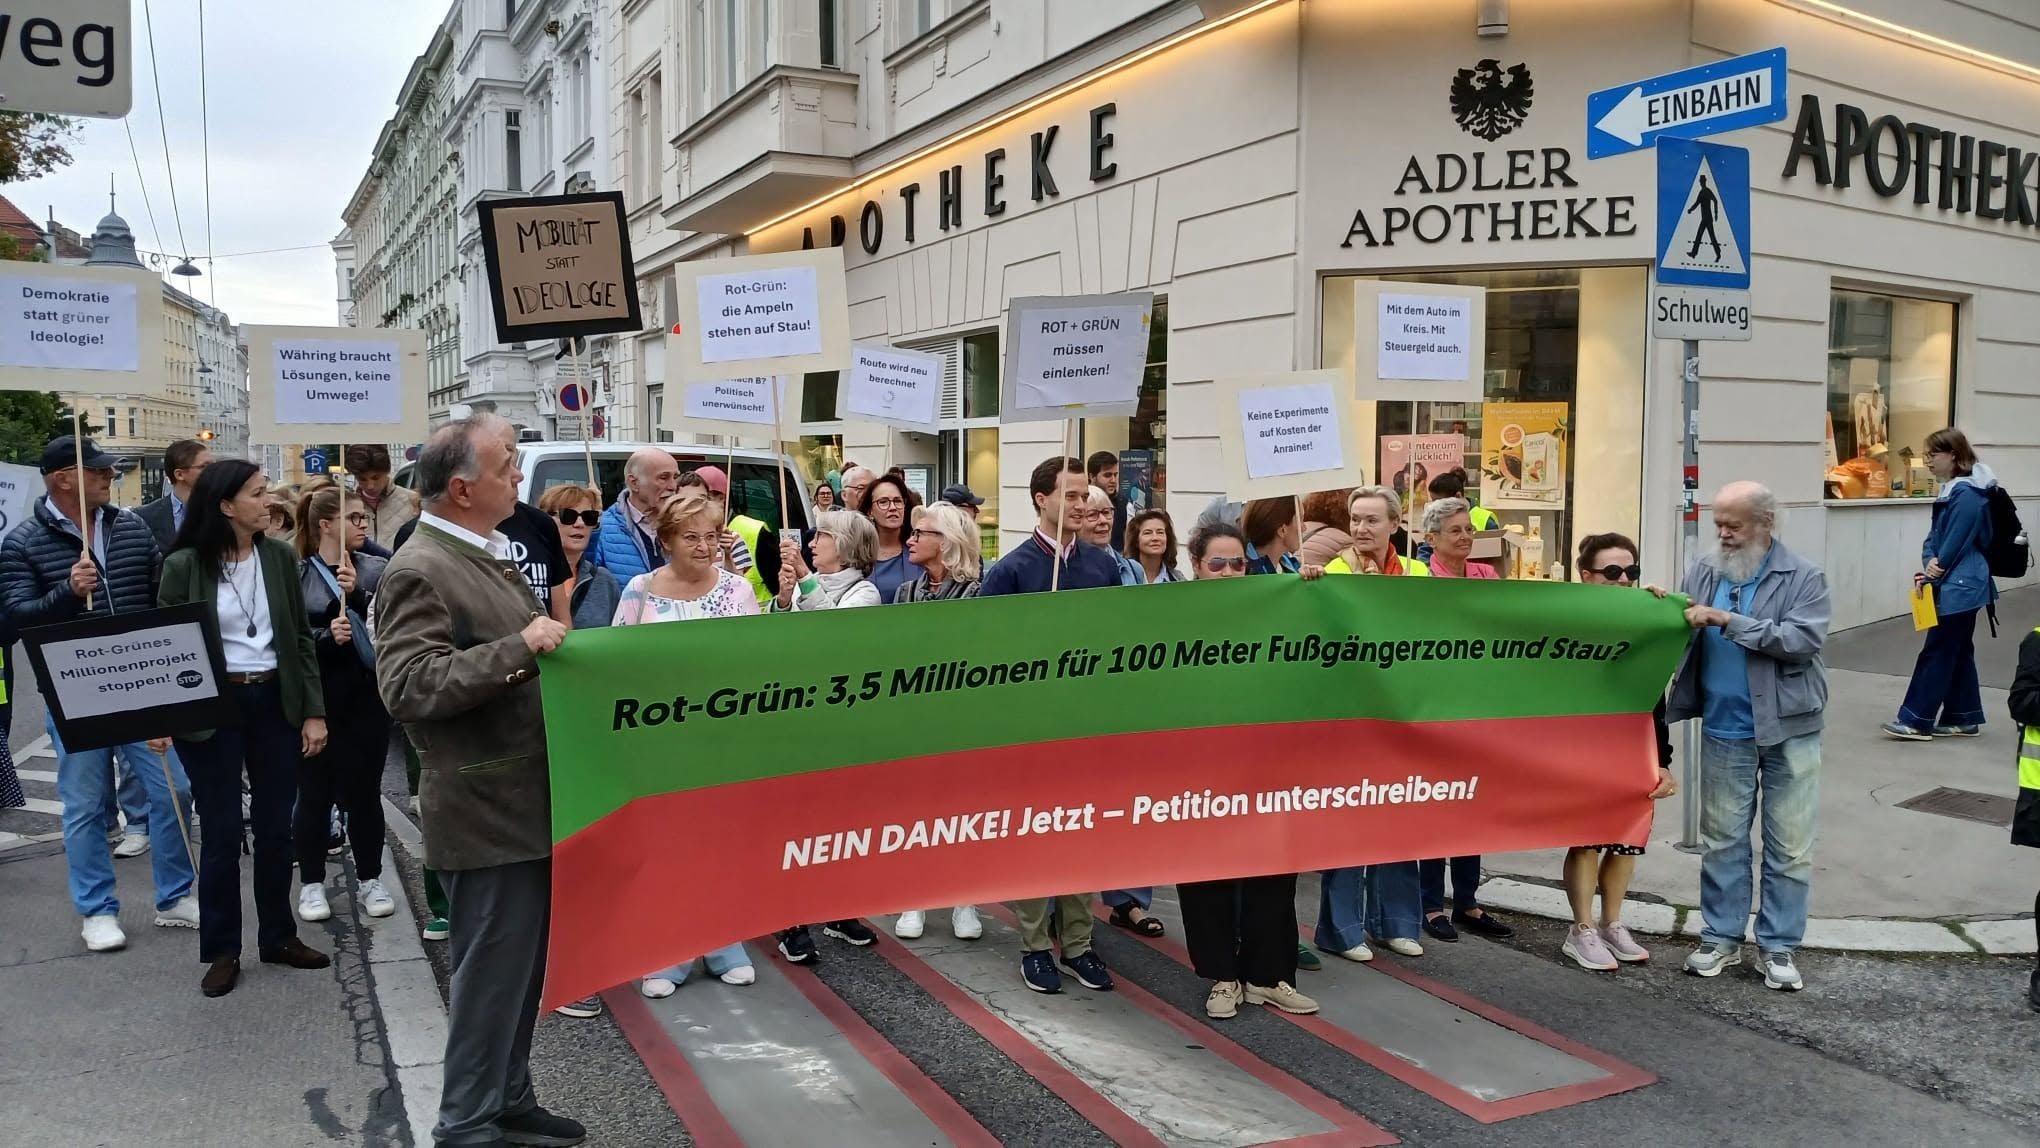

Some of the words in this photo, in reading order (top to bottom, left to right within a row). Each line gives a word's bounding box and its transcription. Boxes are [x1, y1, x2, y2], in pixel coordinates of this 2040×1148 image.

[1647, 74, 1762, 128] EINBAHN
[1781, 94, 2040, 229] APOTHEK
[1394, 147, 1579, 195] ADLER
[1340, 195, 1638, 249] APOTHEKE
[545, 256, 581, 270] STATT
[22, 286, 110, 303] Demokratie
[725, 280, 787, 295] Rot-Grün:
[513, 281, 617, 315] IDEOLOGIE
[23, 309, 58, 321] statt
[62, 312, 110, 325] grüner
[721, 305, 741, 317] die
[744, 301, 794, 316] Ampeln
[1386, 304, 1402, 315] Mit
[1404, 305, 1424, 316] dem
[1426, 306, 1447, 317] Auto
[1449, 307, 1460, 317] im
[1656, 296, 1749, 331] Schulweg
[707, 326, 751, 339] stehen
[754, 322, 774, 334] auf
[777, 319, 811, 332] Stau!
[1041, 320, 1068, 334] ROT
[1070, 322, 1078, 331] +
[1081, 315, 1120, 332] GRÜN
[1403, 323, 1429, 334] Kreis.
[1431, 324, 1446, 335] Mit
[30, 330, 104, 346] Ideologie!
[1053, 343, 1104, 356] müssen
[1385, 341, 1435, 354] Steuergeld
[1437, 343, 1461, 354] auch.
[280, 349, 337, 363] Währing
[340, 350, 392, 362] braucht
[860, 356, 887, 369] Route
[889, 363, 909, 373] wird
[911, 367, 928, 376] neu
[1042, 363, 1110, 379] einlenken!
[282, 369, 352, 383] Lösungen,
[355, 370, 391, 381] keine
[868, 373, 916, 389] berechnet
[306, 389, 369, 402] Umwege!
[714, 386, 754, 398] Politisch
[702, 400, 765, 412] unerwünscht!
[1247, 410, 1273, 421] Keine
[1274, 405, 1329, 420] Experimente
[1259, 428, 1274, 438] auf
[1276, 426, 1306, 436] Kosten
[1307, 423, 1322, 433] der
[1273, 441, 1313, 455] Anrainer!
[311, 457, 320, 470] P
[75, 637, 173, 660] Rot-Grünes
[59, 651, 198, 680] Millionenprojekt
[97, 673, 171, 693] stoppen!
[178, 673, 202, 685] STOP
[611, 680, 818, 732] Rot-Grün:
[825, 671, 882, 709] 3,5
[889, 655, 1050, 699] Millionen
[1056, 648, 1102, 680] für
[1106, 641, 1167, 675] 100
[1172, 636, 1260, 670] Meter
[1267, 633, 1486, 670] Fußgängerzone
[1490, 635, 1548, 661] und
[1549, 636, 1632, 664] Stau?
[781, 827, 876, 872] NEIN
[878, 808, 1012, 855] DANKE!
[1015, 802, 1097, 836] Jetzt
[1132, 791, 1250, 826] Petition
[1255, 775, 1478, 816] unterschreiben!
